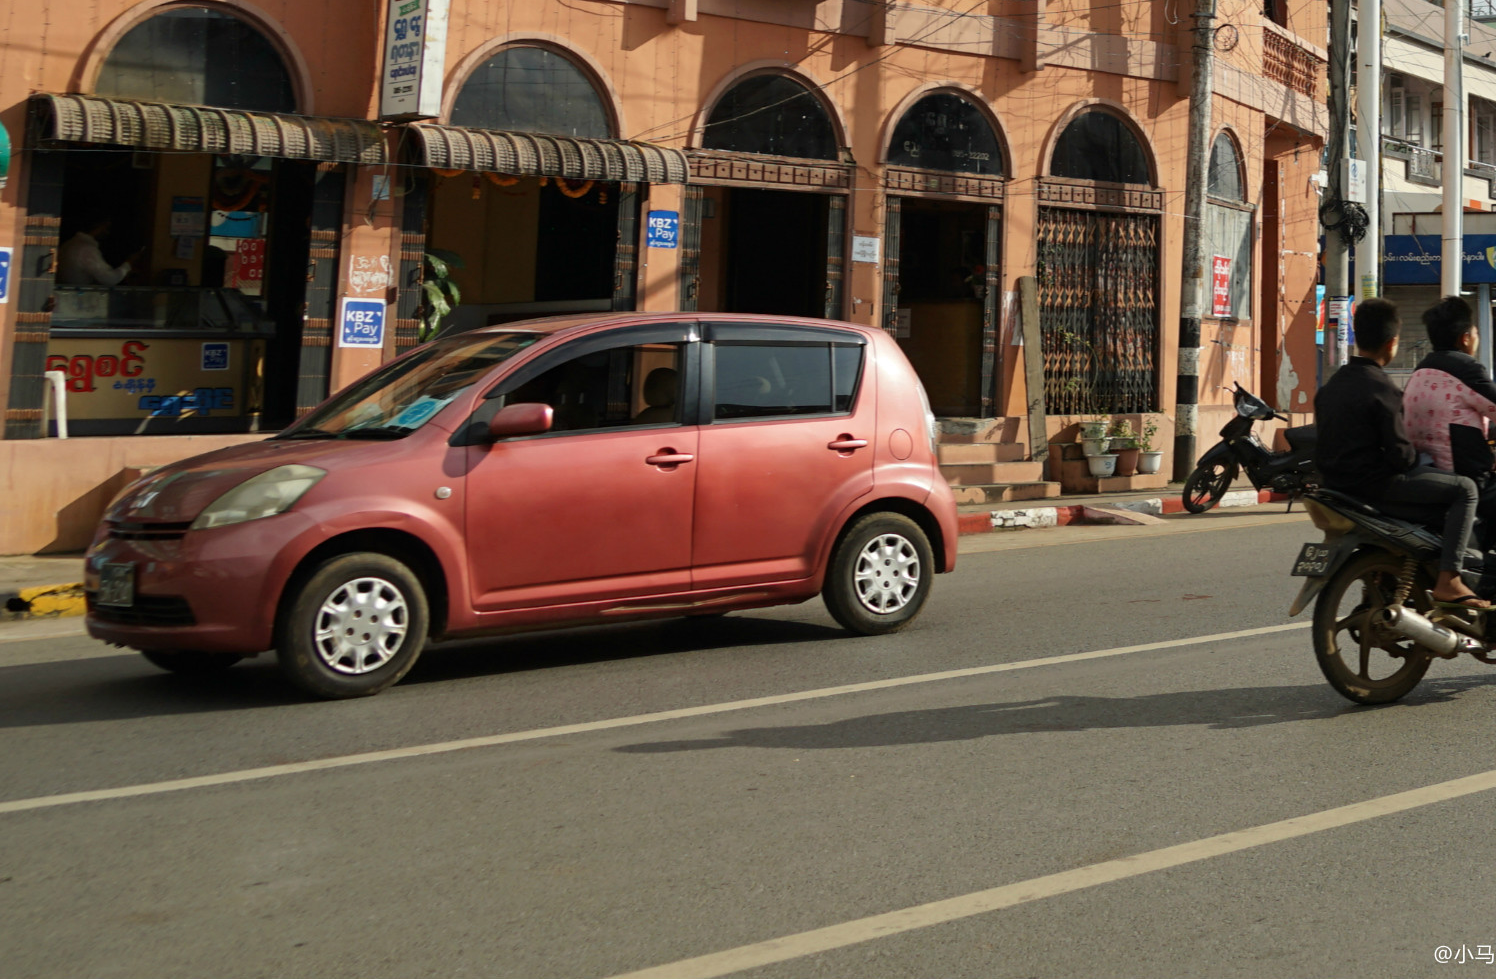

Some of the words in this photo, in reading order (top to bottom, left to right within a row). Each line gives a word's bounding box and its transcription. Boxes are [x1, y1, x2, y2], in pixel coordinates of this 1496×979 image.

[650, 217, 672, 229] KBZ
[655, 228, 675, 241] Pay
[346, 310, 374, 322] KBZ
[354, 322, 378, 336] Pay
